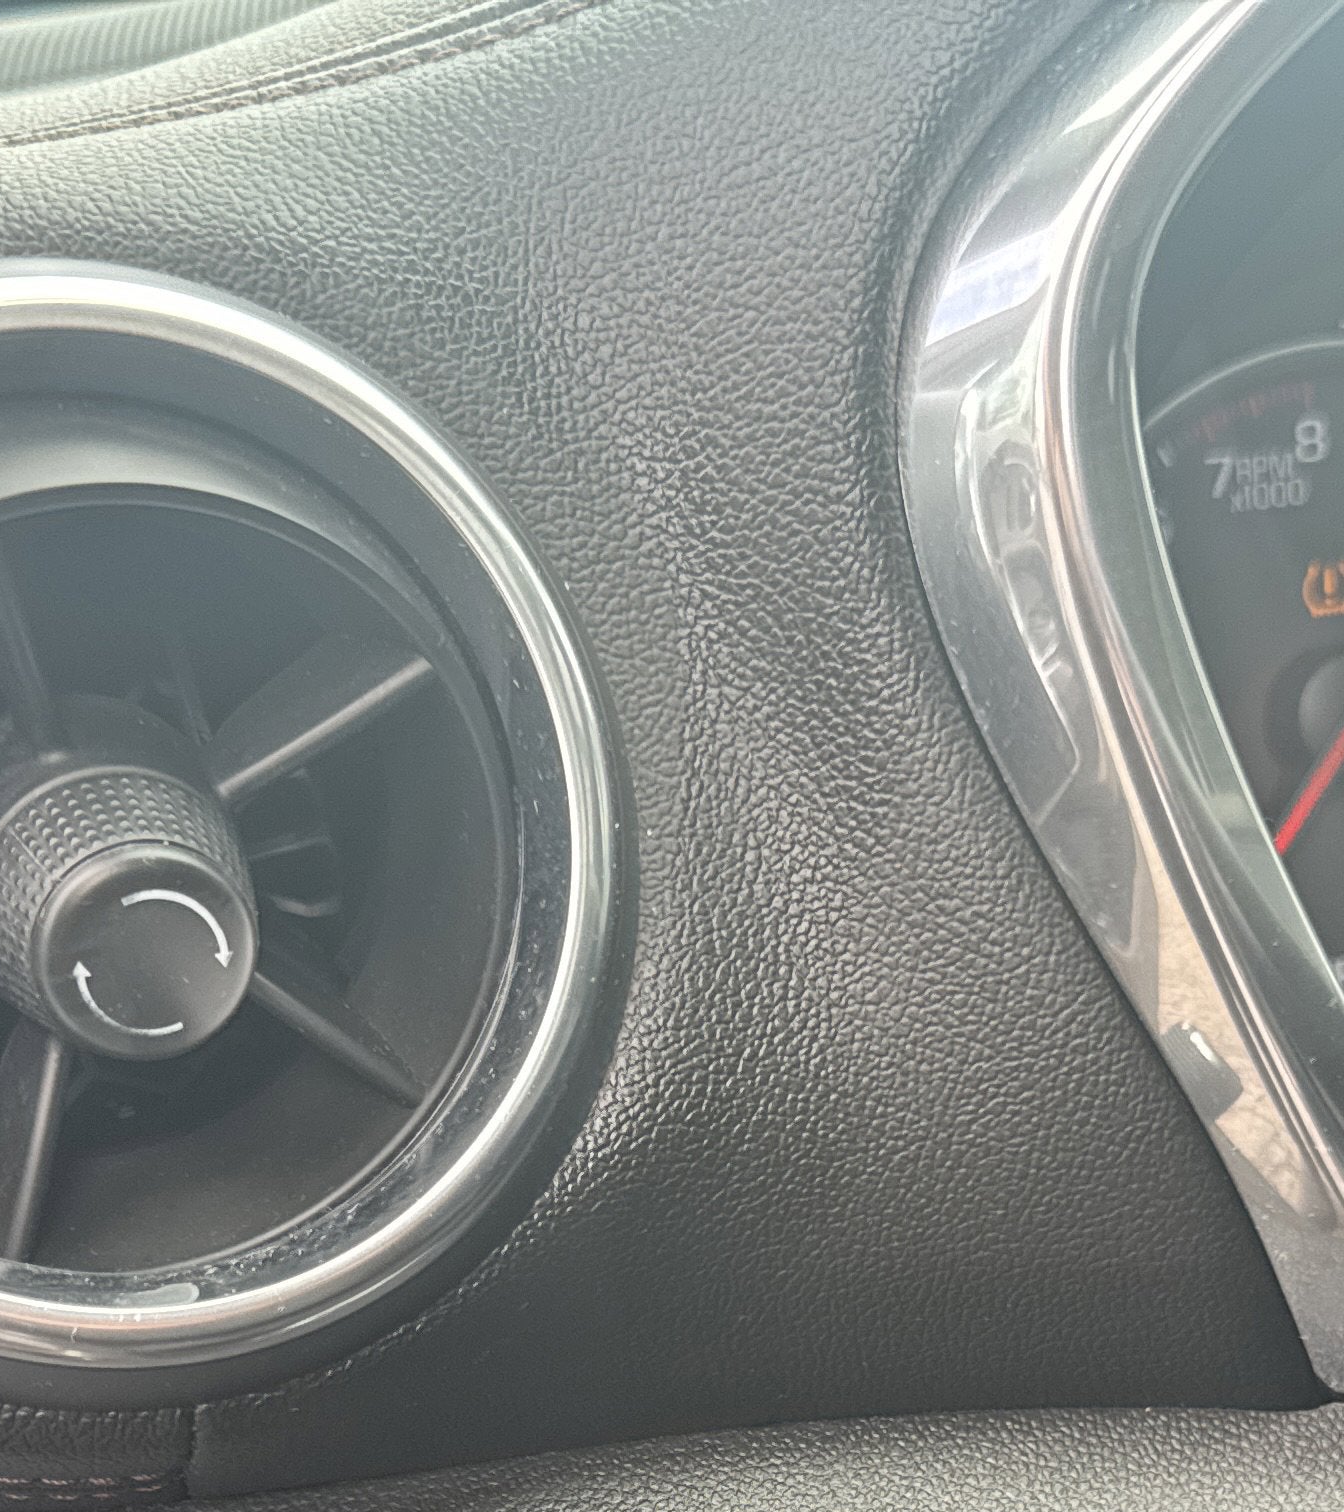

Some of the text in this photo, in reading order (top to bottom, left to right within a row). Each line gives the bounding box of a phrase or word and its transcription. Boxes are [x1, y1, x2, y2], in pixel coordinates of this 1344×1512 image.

[1295, 418, 1330, 463] 8
[1204, 455, 1234, 499] 7
[1236, 453, 1297, 484] RPM
